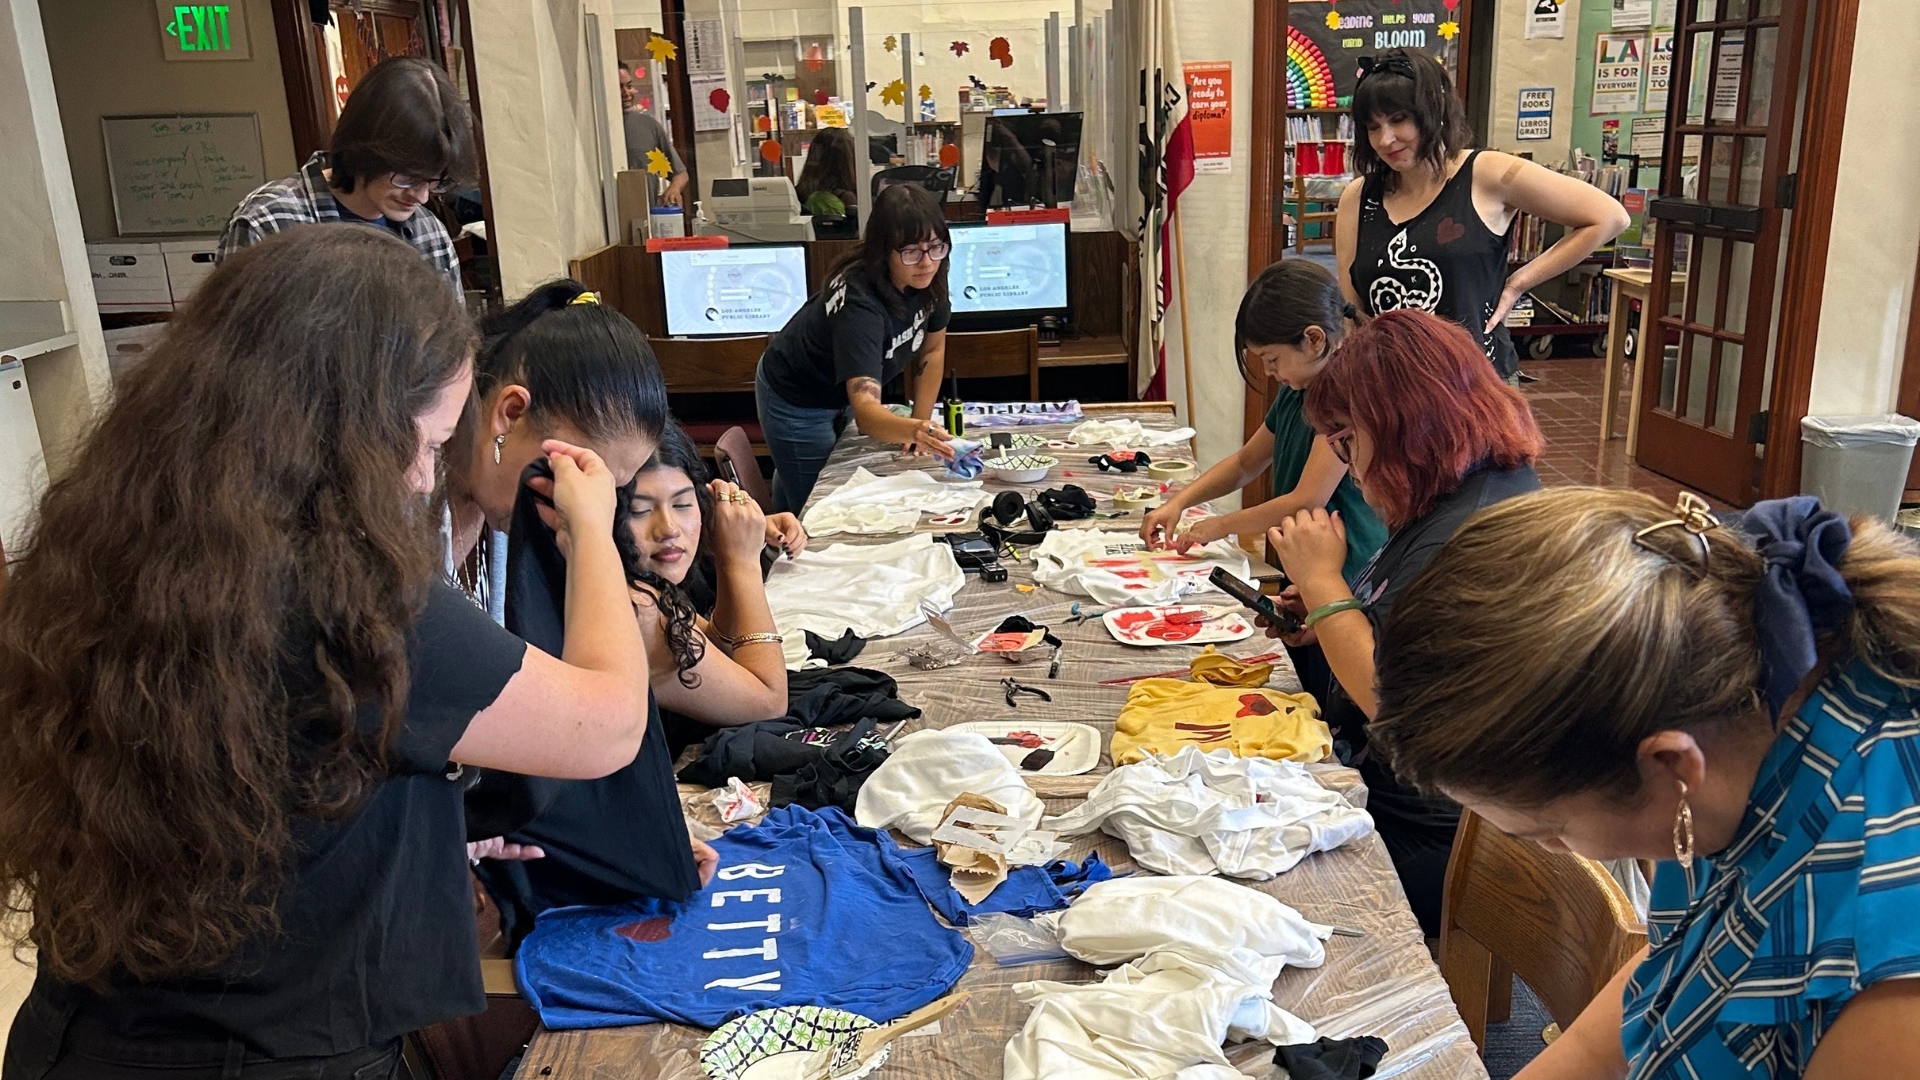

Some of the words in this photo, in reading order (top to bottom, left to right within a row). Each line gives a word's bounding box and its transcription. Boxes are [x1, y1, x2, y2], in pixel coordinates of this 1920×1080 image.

[175, 6, 230, 50] EXIT
[1600, 39, 1640, 63] LA
[1598, 68, 1609, 78] IS
[1614, 67, 1638, 77] FOR
[1208, 78, 1222, 88] you
[1597, 82, 1637, 90] EVERYONE
[1193, 88, 1215, 99] ready
[1216, 88, 1224, 97] to
[1191, 101, 1209, 109] earn
[1210, 101, 1228, 110] your
[1522, 100, 1549, 108] BOOKS
[702, 863, 786, 991] BETTY
